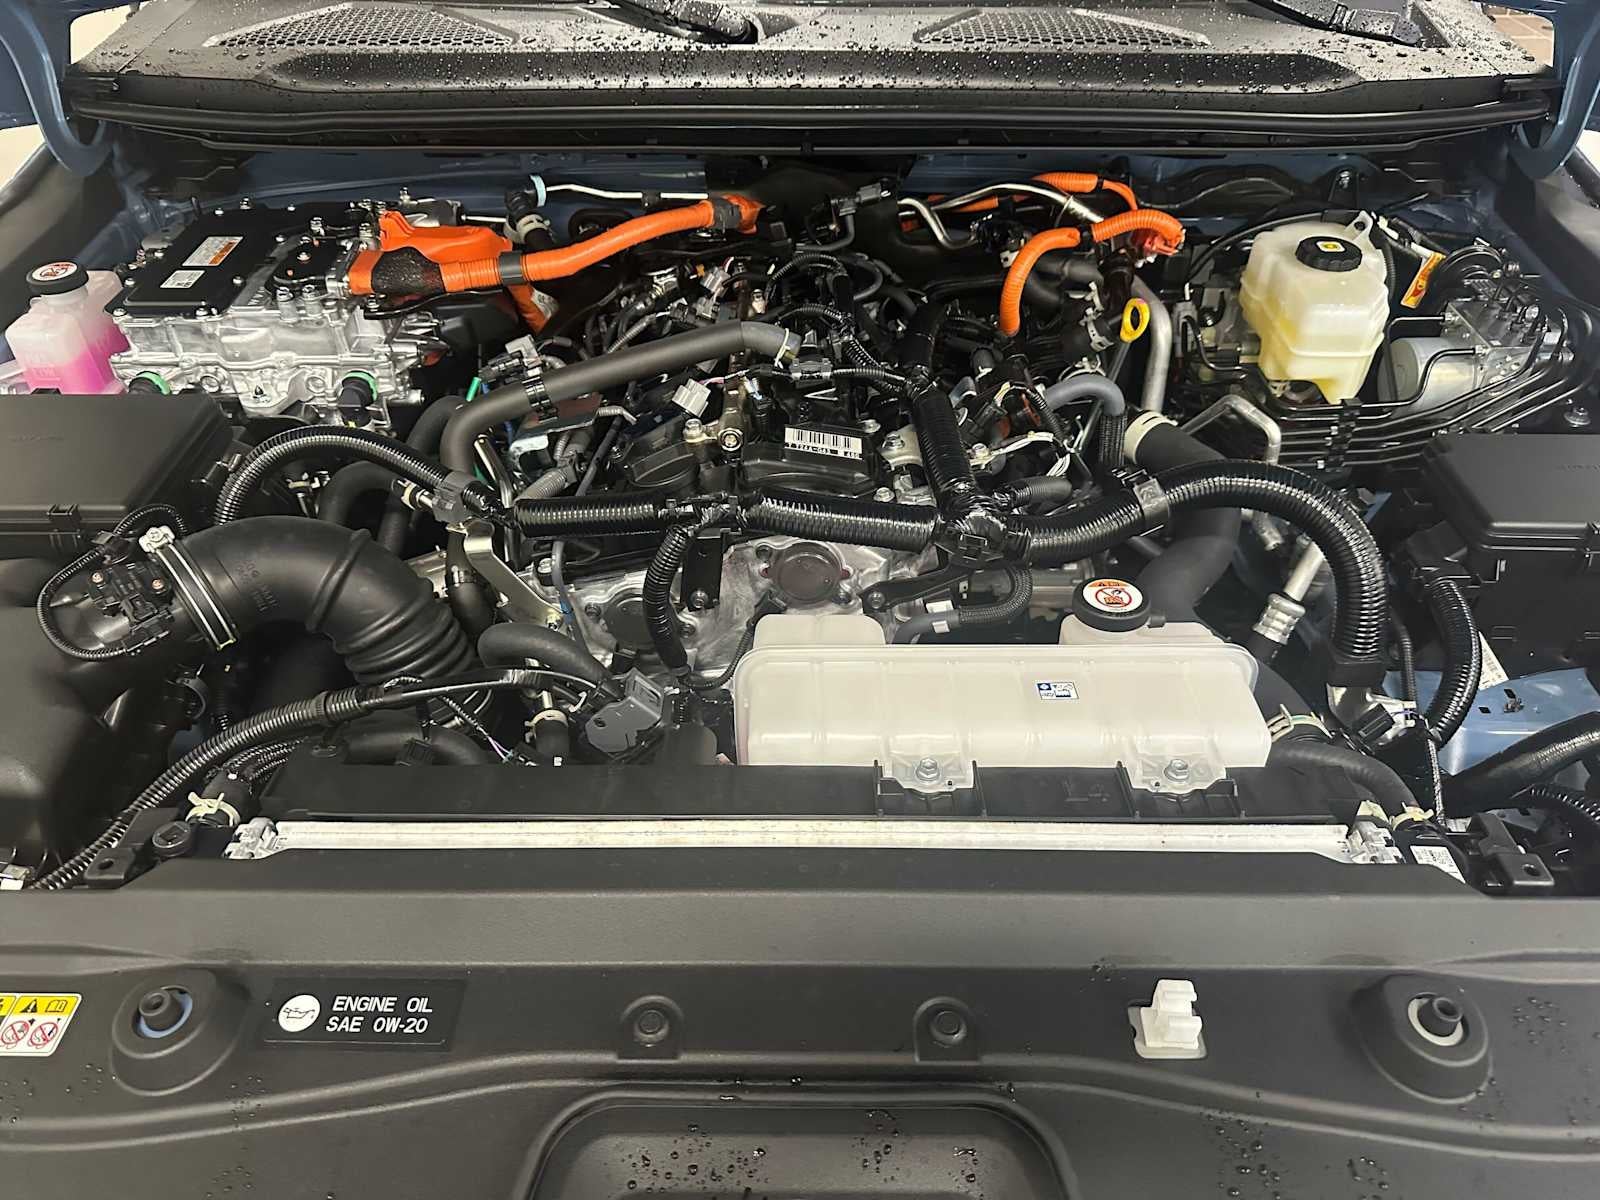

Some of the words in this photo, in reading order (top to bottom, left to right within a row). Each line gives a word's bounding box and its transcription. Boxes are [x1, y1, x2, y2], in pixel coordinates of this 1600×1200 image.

[332, 995, 397, 1012] ENGINE
[406, 997, 433, 1013] OIL
[325, 1016, 364, 1033] SAE
[373, 1017, 429, 1034] 0W-20
